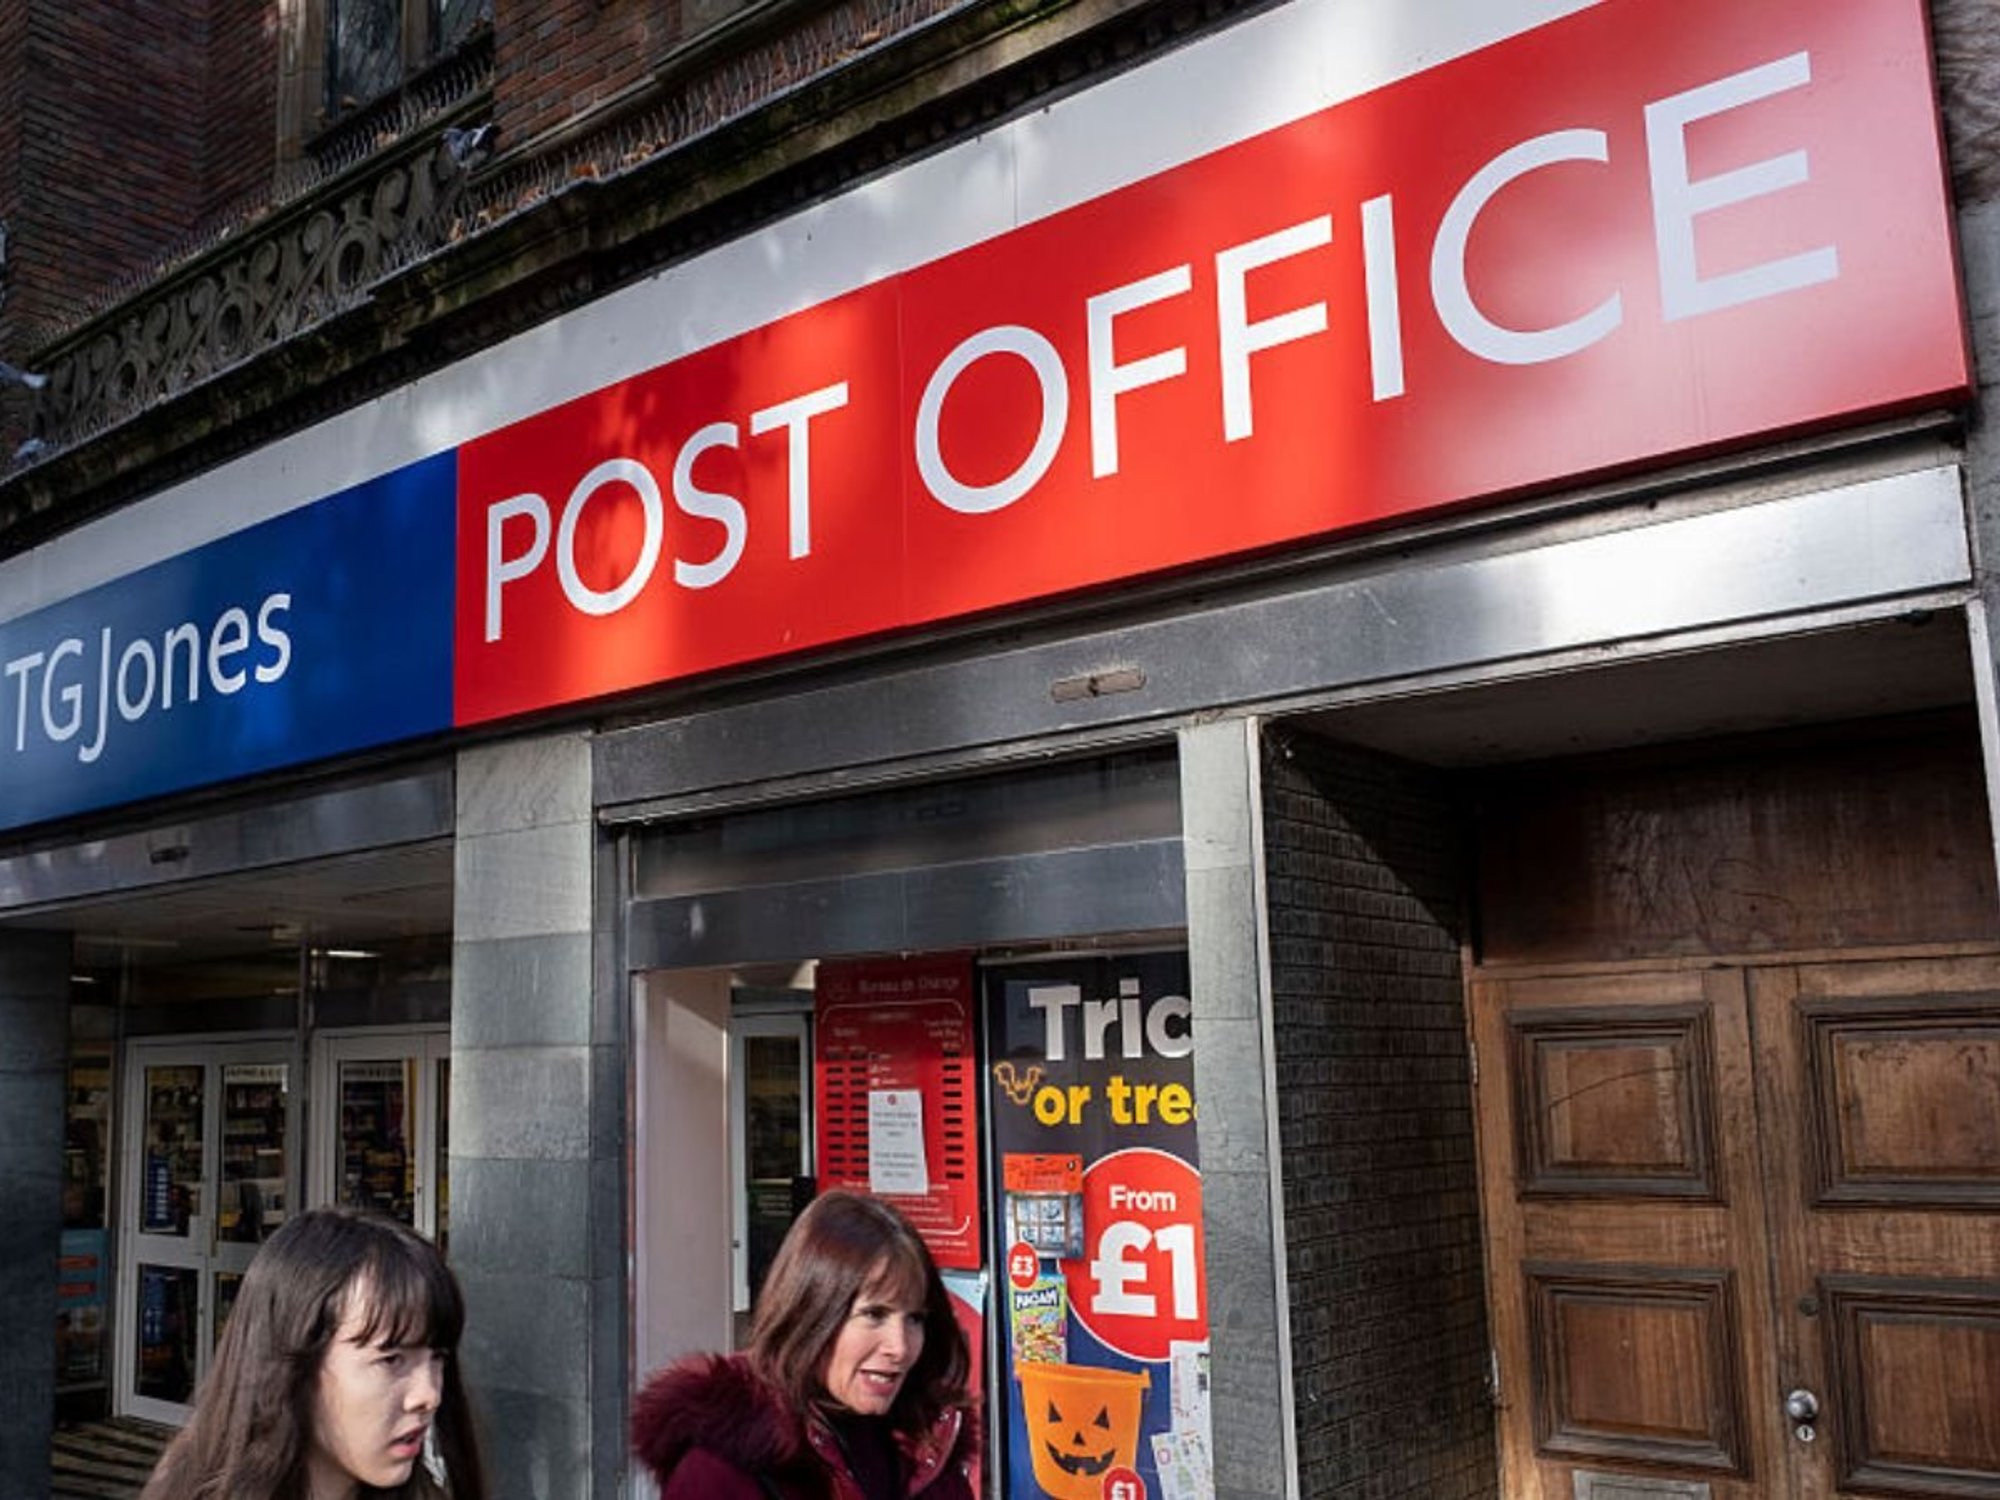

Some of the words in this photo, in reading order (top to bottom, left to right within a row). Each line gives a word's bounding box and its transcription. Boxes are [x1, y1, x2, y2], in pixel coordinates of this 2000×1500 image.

[486, 381, 849, 642] POST
[915, 50, 1839, 513] OFFICE
[1028, 978, 1193, 1060] Tric
[1034, 1085, 1091, 1126] or
[1106, 1075, 1198, 1125] tre
[1109, 1185, 1176, 1212] From
[1011, 1255, 1034, 1277] £3
[1090, 1220, 1199, 1320] £1
